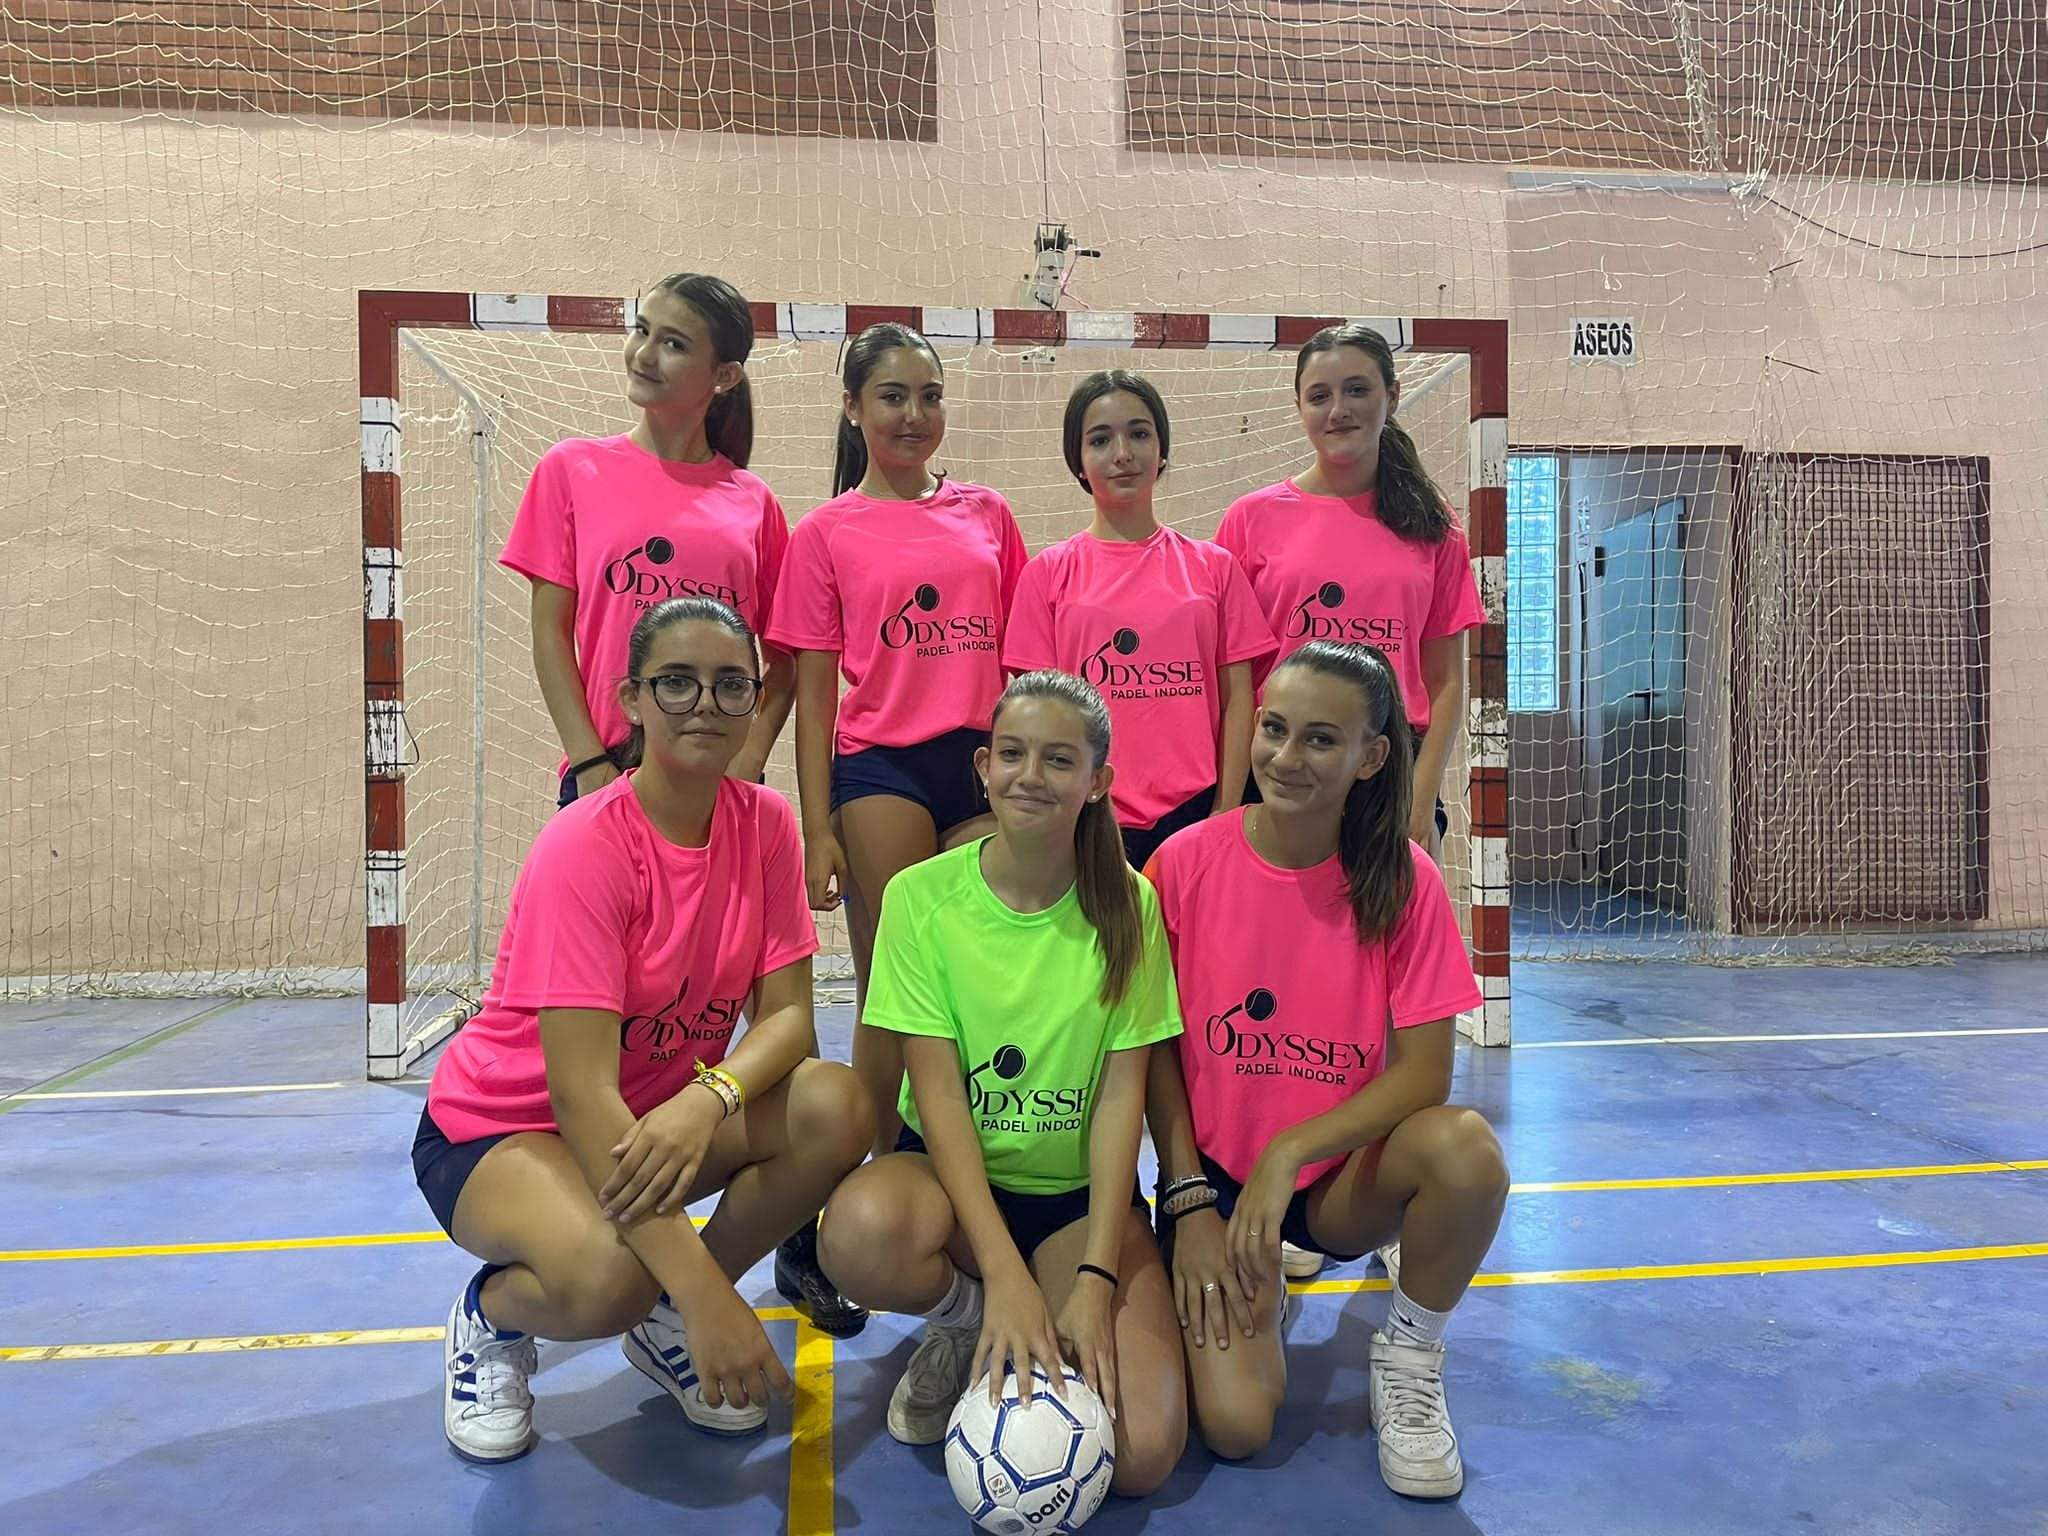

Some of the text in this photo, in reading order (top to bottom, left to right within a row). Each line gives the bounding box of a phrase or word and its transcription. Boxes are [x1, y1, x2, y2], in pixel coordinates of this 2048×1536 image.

[1573, 322, 1633, 356] ASEOS
[880, 614, 997, 649] ODYSSE
[1286, 605, 1407, 641] ODYSSE
[916, 641, 996, 657] PADEL INDOOR
[1081, 654, 1204, 687] ODYSSE
[1111, 686, 1203, 699] PADEL INDOOR
[1206, 1014, 1376, 1069] ODYSSEY
[1235, 1063, 1346, 1085] PADEL INDOOR
[981, 1117, 1081, 1132] PADEL INDOO
